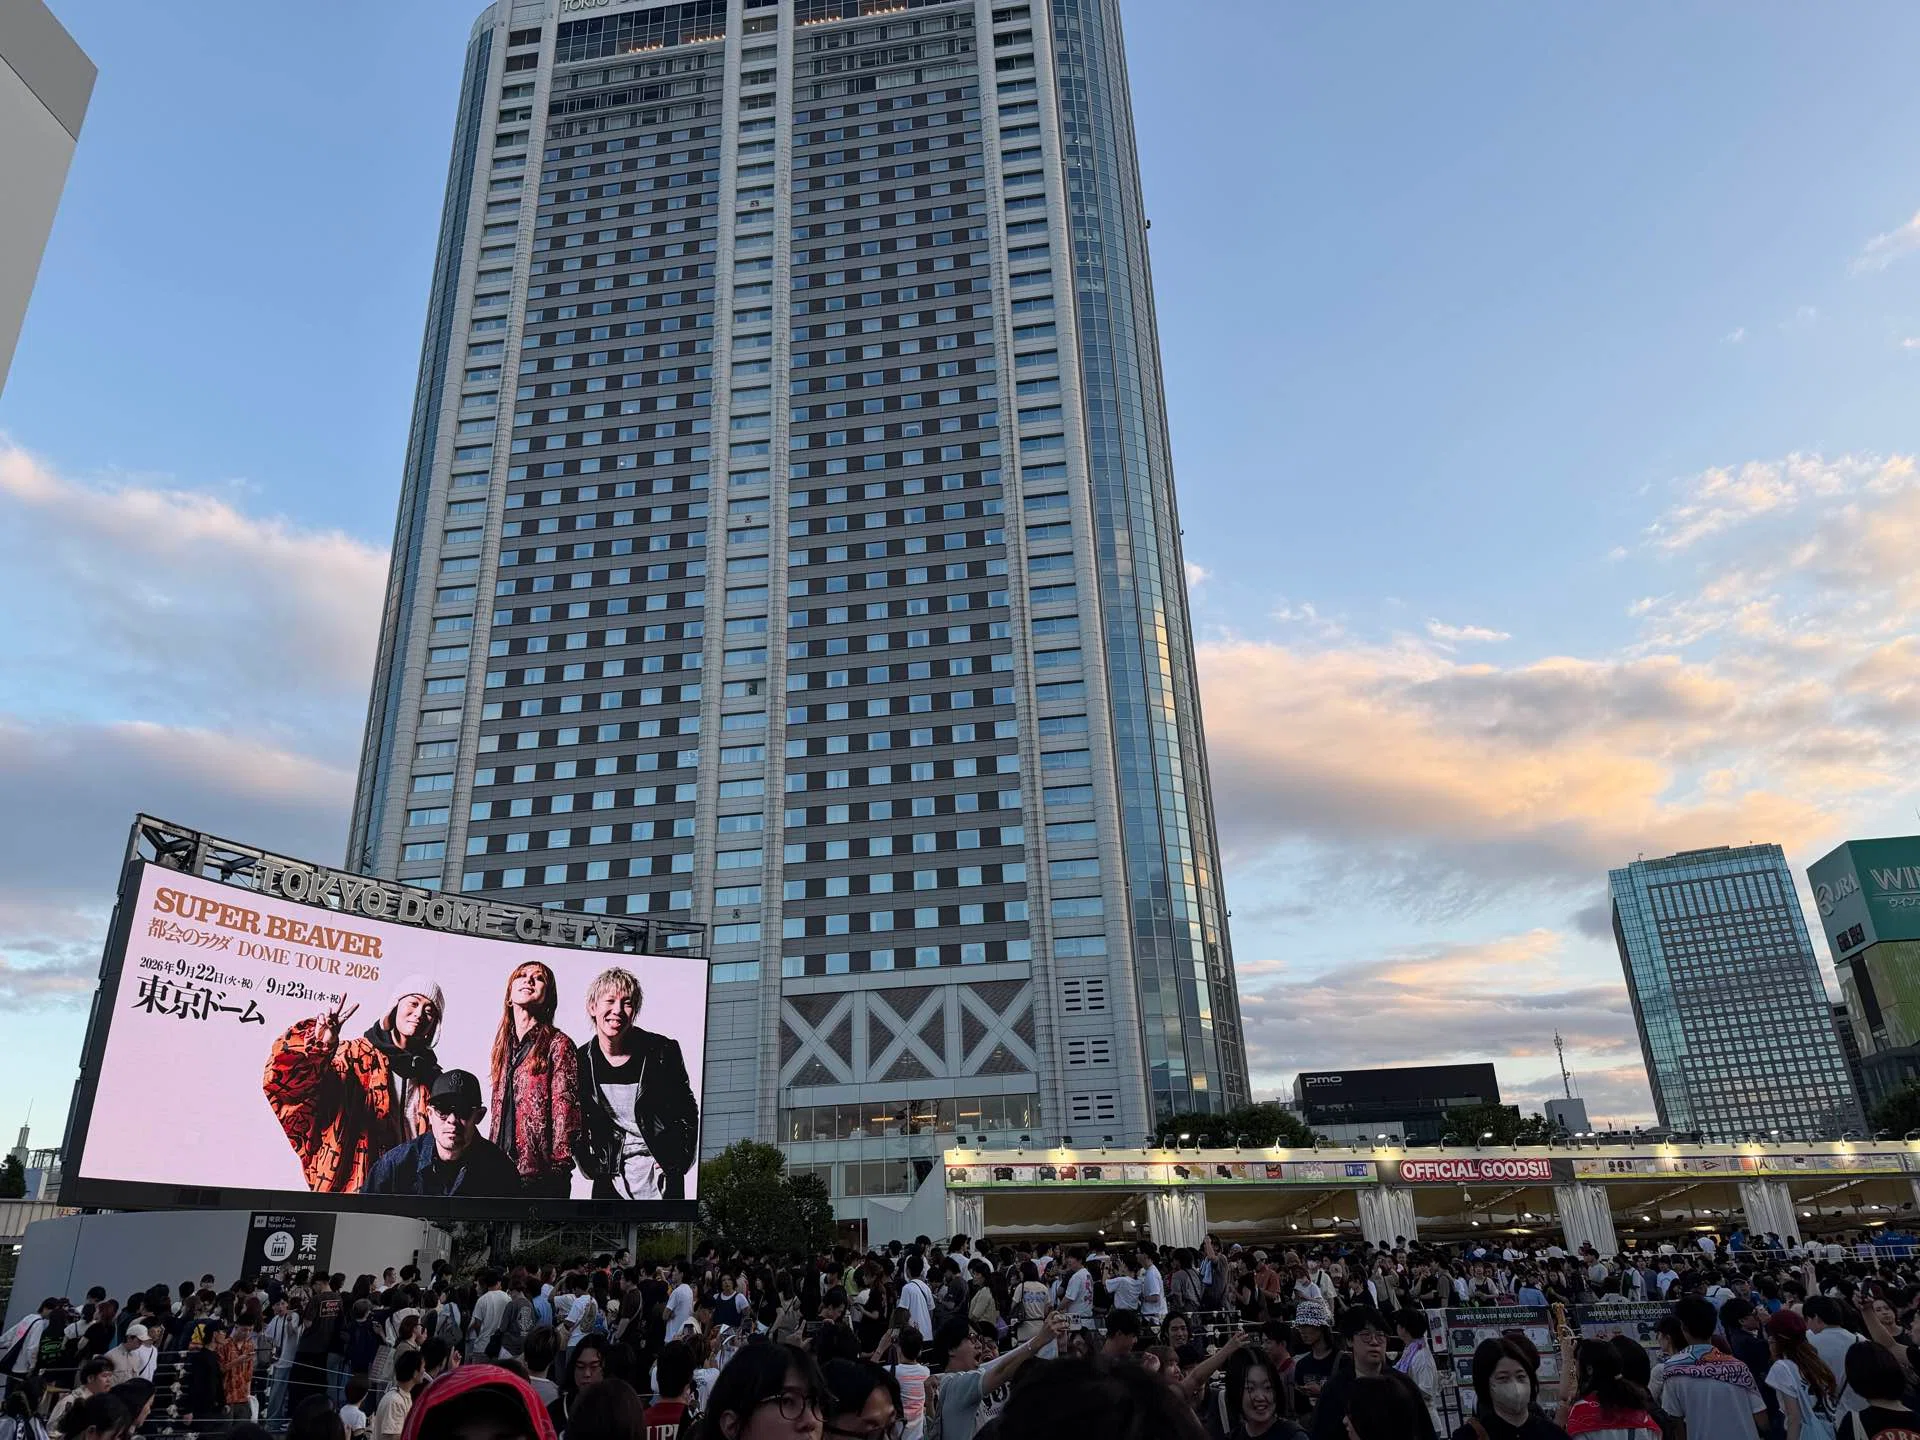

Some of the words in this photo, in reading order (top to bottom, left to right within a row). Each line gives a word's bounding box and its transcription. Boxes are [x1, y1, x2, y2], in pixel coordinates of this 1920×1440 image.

[256, 859, 388, 916] TOKYO
[399, 893, 503, 935] DOME
[515, 911, 617, 948] CITY
[1834, 873, 1860, 903] JRA
[153, 887, 260, 935] SUPER
[264, 914, 383, 959] BEAVER
[147, 917, 233, 951] 都会のラクダ
[238, 940, 290, 966] DOME
[295, 953, 340, 975] TOUR
[344, 962, 380, 982] 2026
[131, 974, 265, 1025] 東京ドーム
[1402, 1162, 1479, 1178] OFFICIAL
[1480, 1160, 1550, 1177] GOODS!!
[300, 1232, 319, 1252] 東
